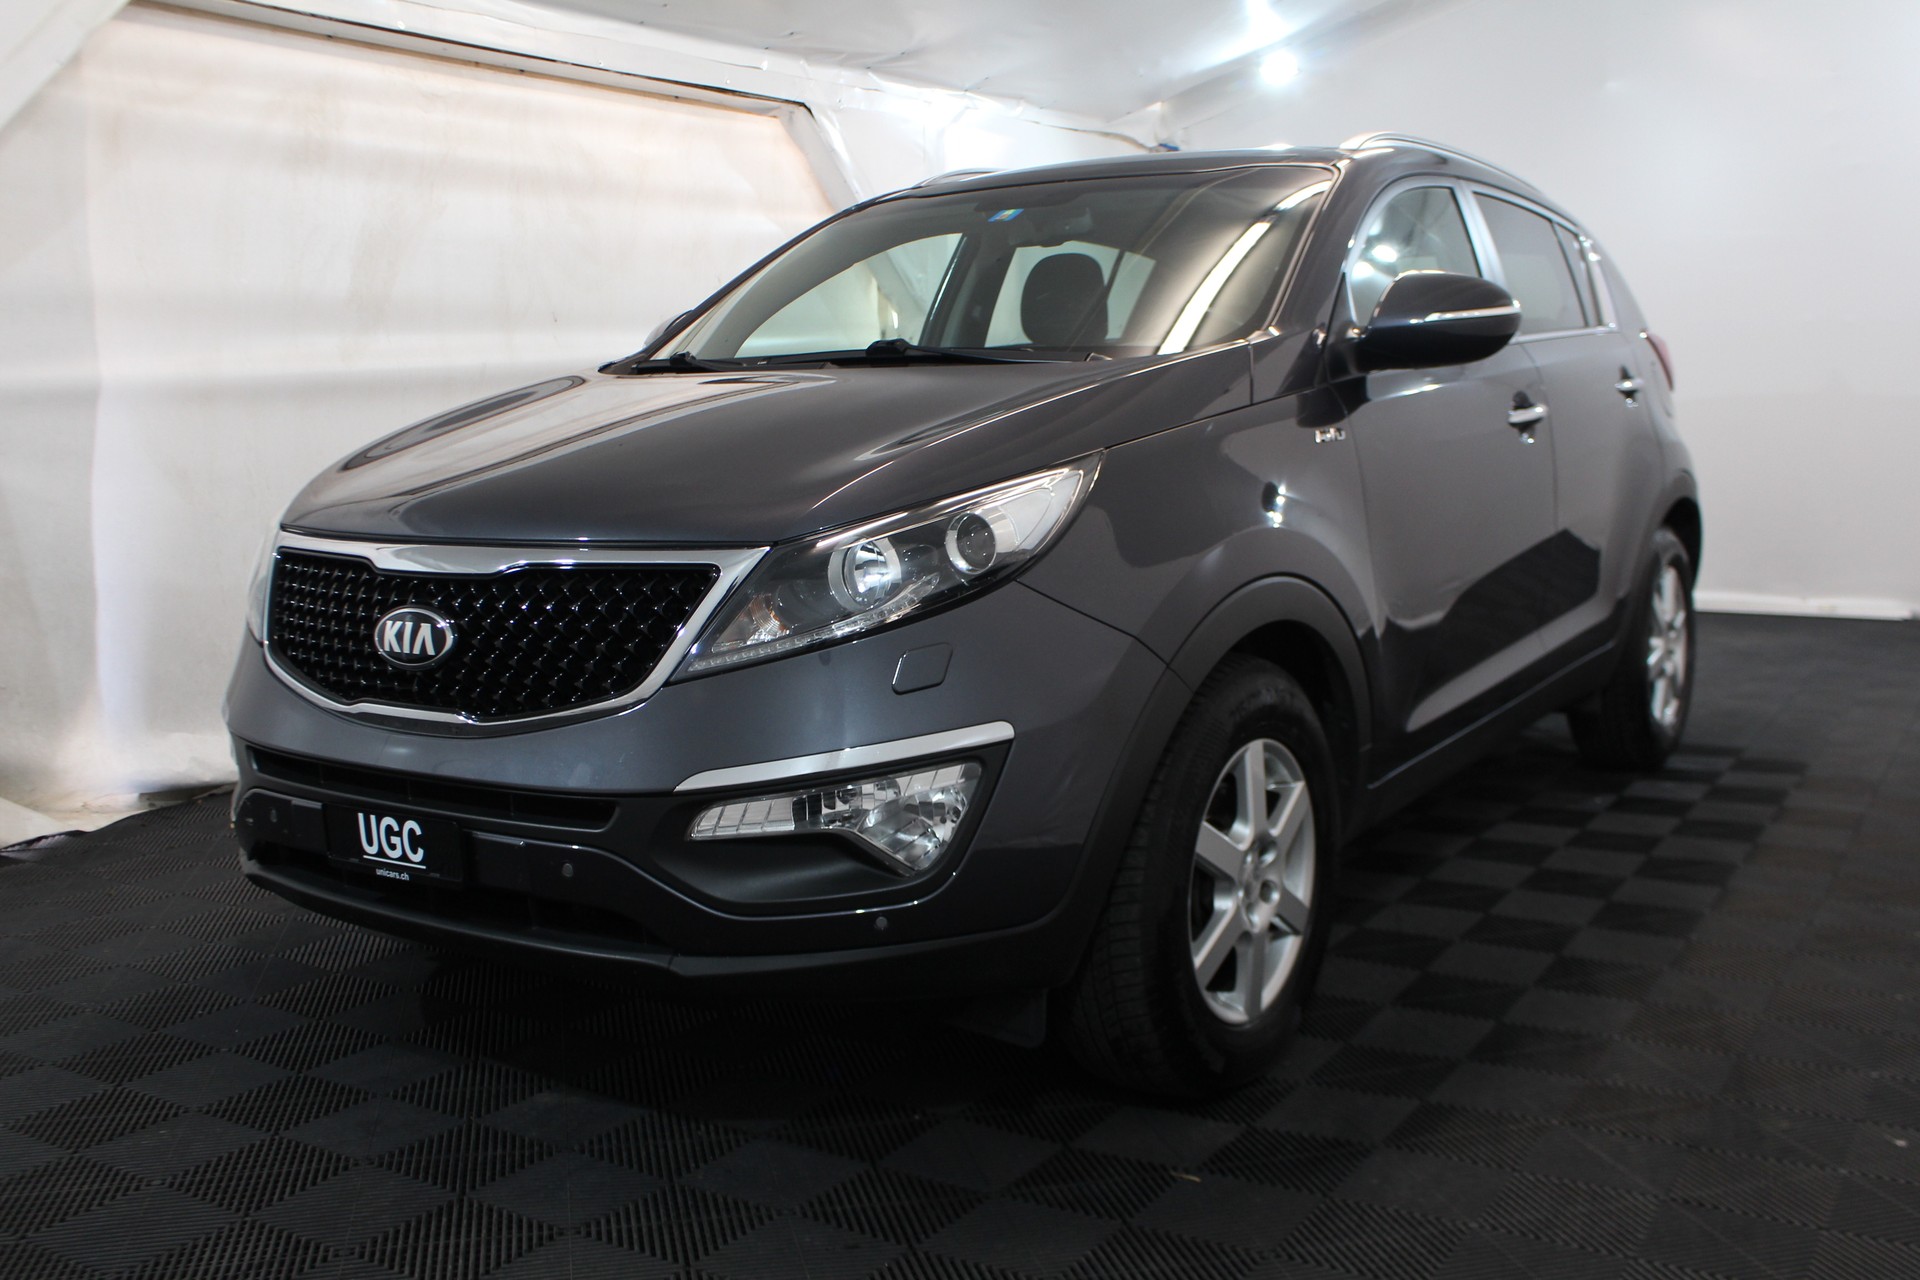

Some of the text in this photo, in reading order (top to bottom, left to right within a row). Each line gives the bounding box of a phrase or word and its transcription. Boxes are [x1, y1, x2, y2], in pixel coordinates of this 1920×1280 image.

[383, 620, 436, 656] KIA
[357, 812, 425, 863] UGC
[375, 868, 410, 881] unicars.ch
